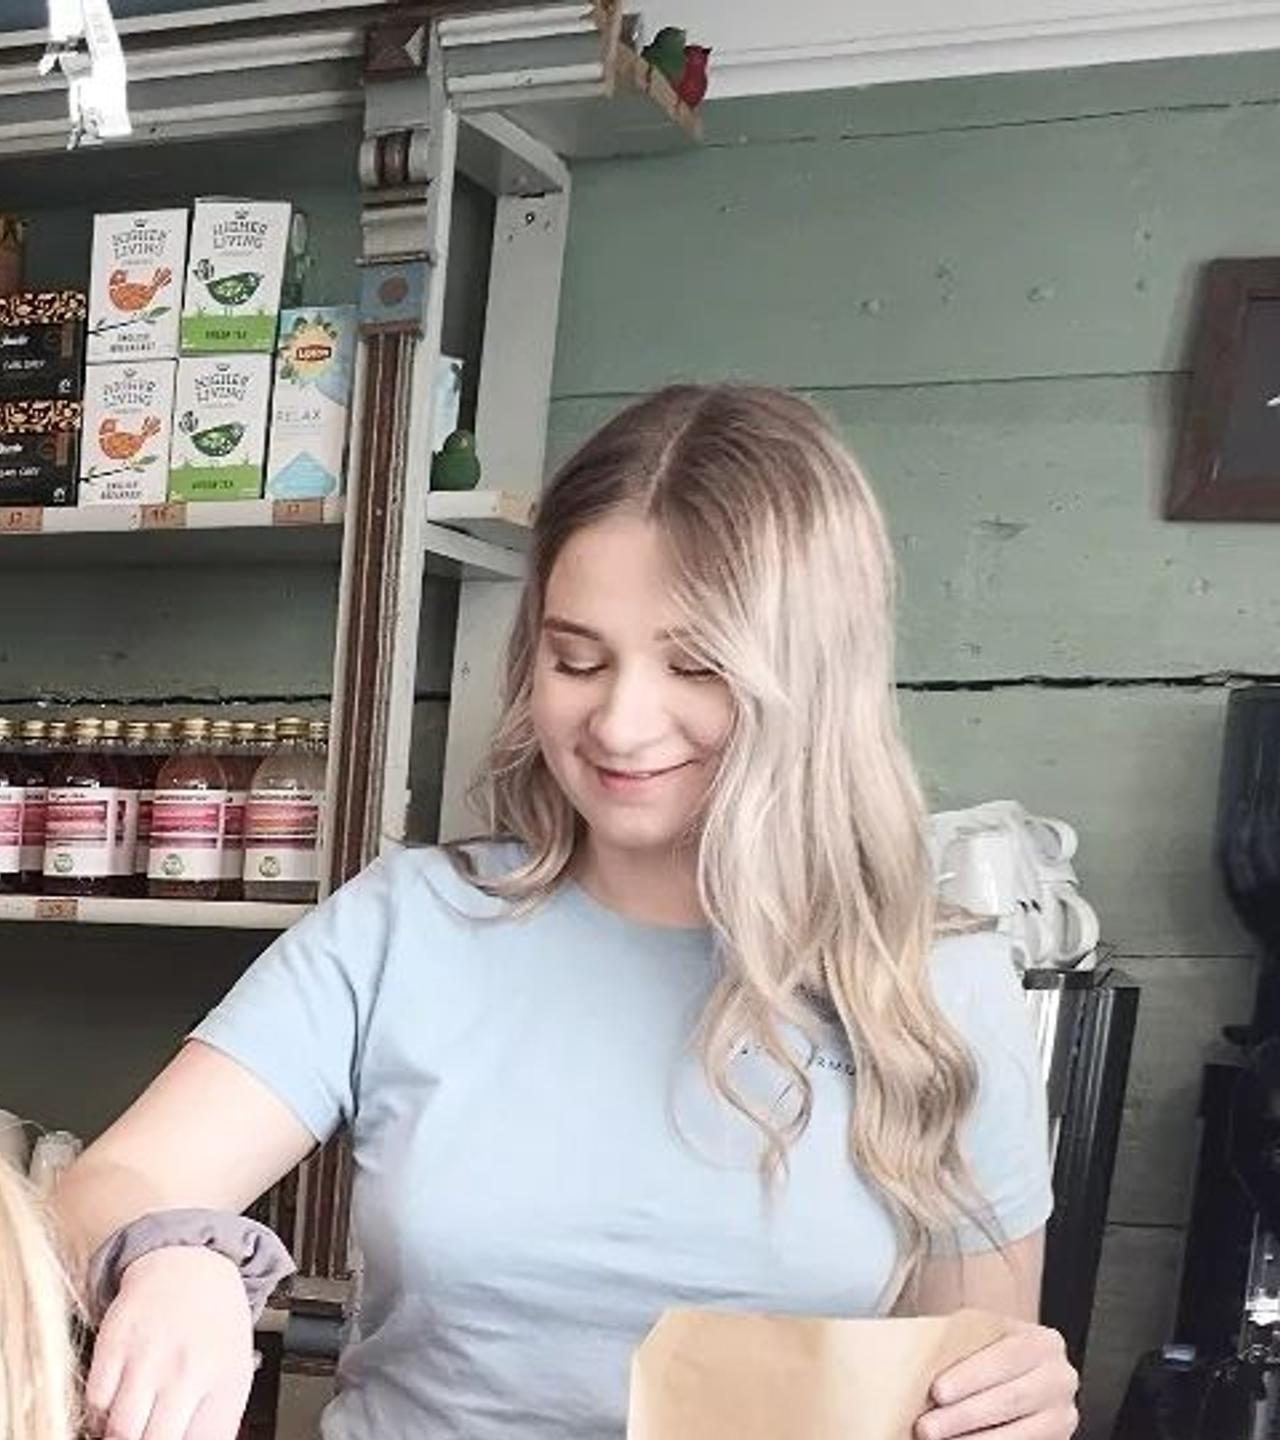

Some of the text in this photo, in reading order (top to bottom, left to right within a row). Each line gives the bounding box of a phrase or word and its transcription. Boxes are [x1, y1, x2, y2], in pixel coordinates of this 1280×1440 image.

[213, 220, 268, 237] HIGHER
[213, 234, 264, 250] LIVING
[114, 242, 165, 260] LIVING
[195, 387, 246, 403] LIVING
